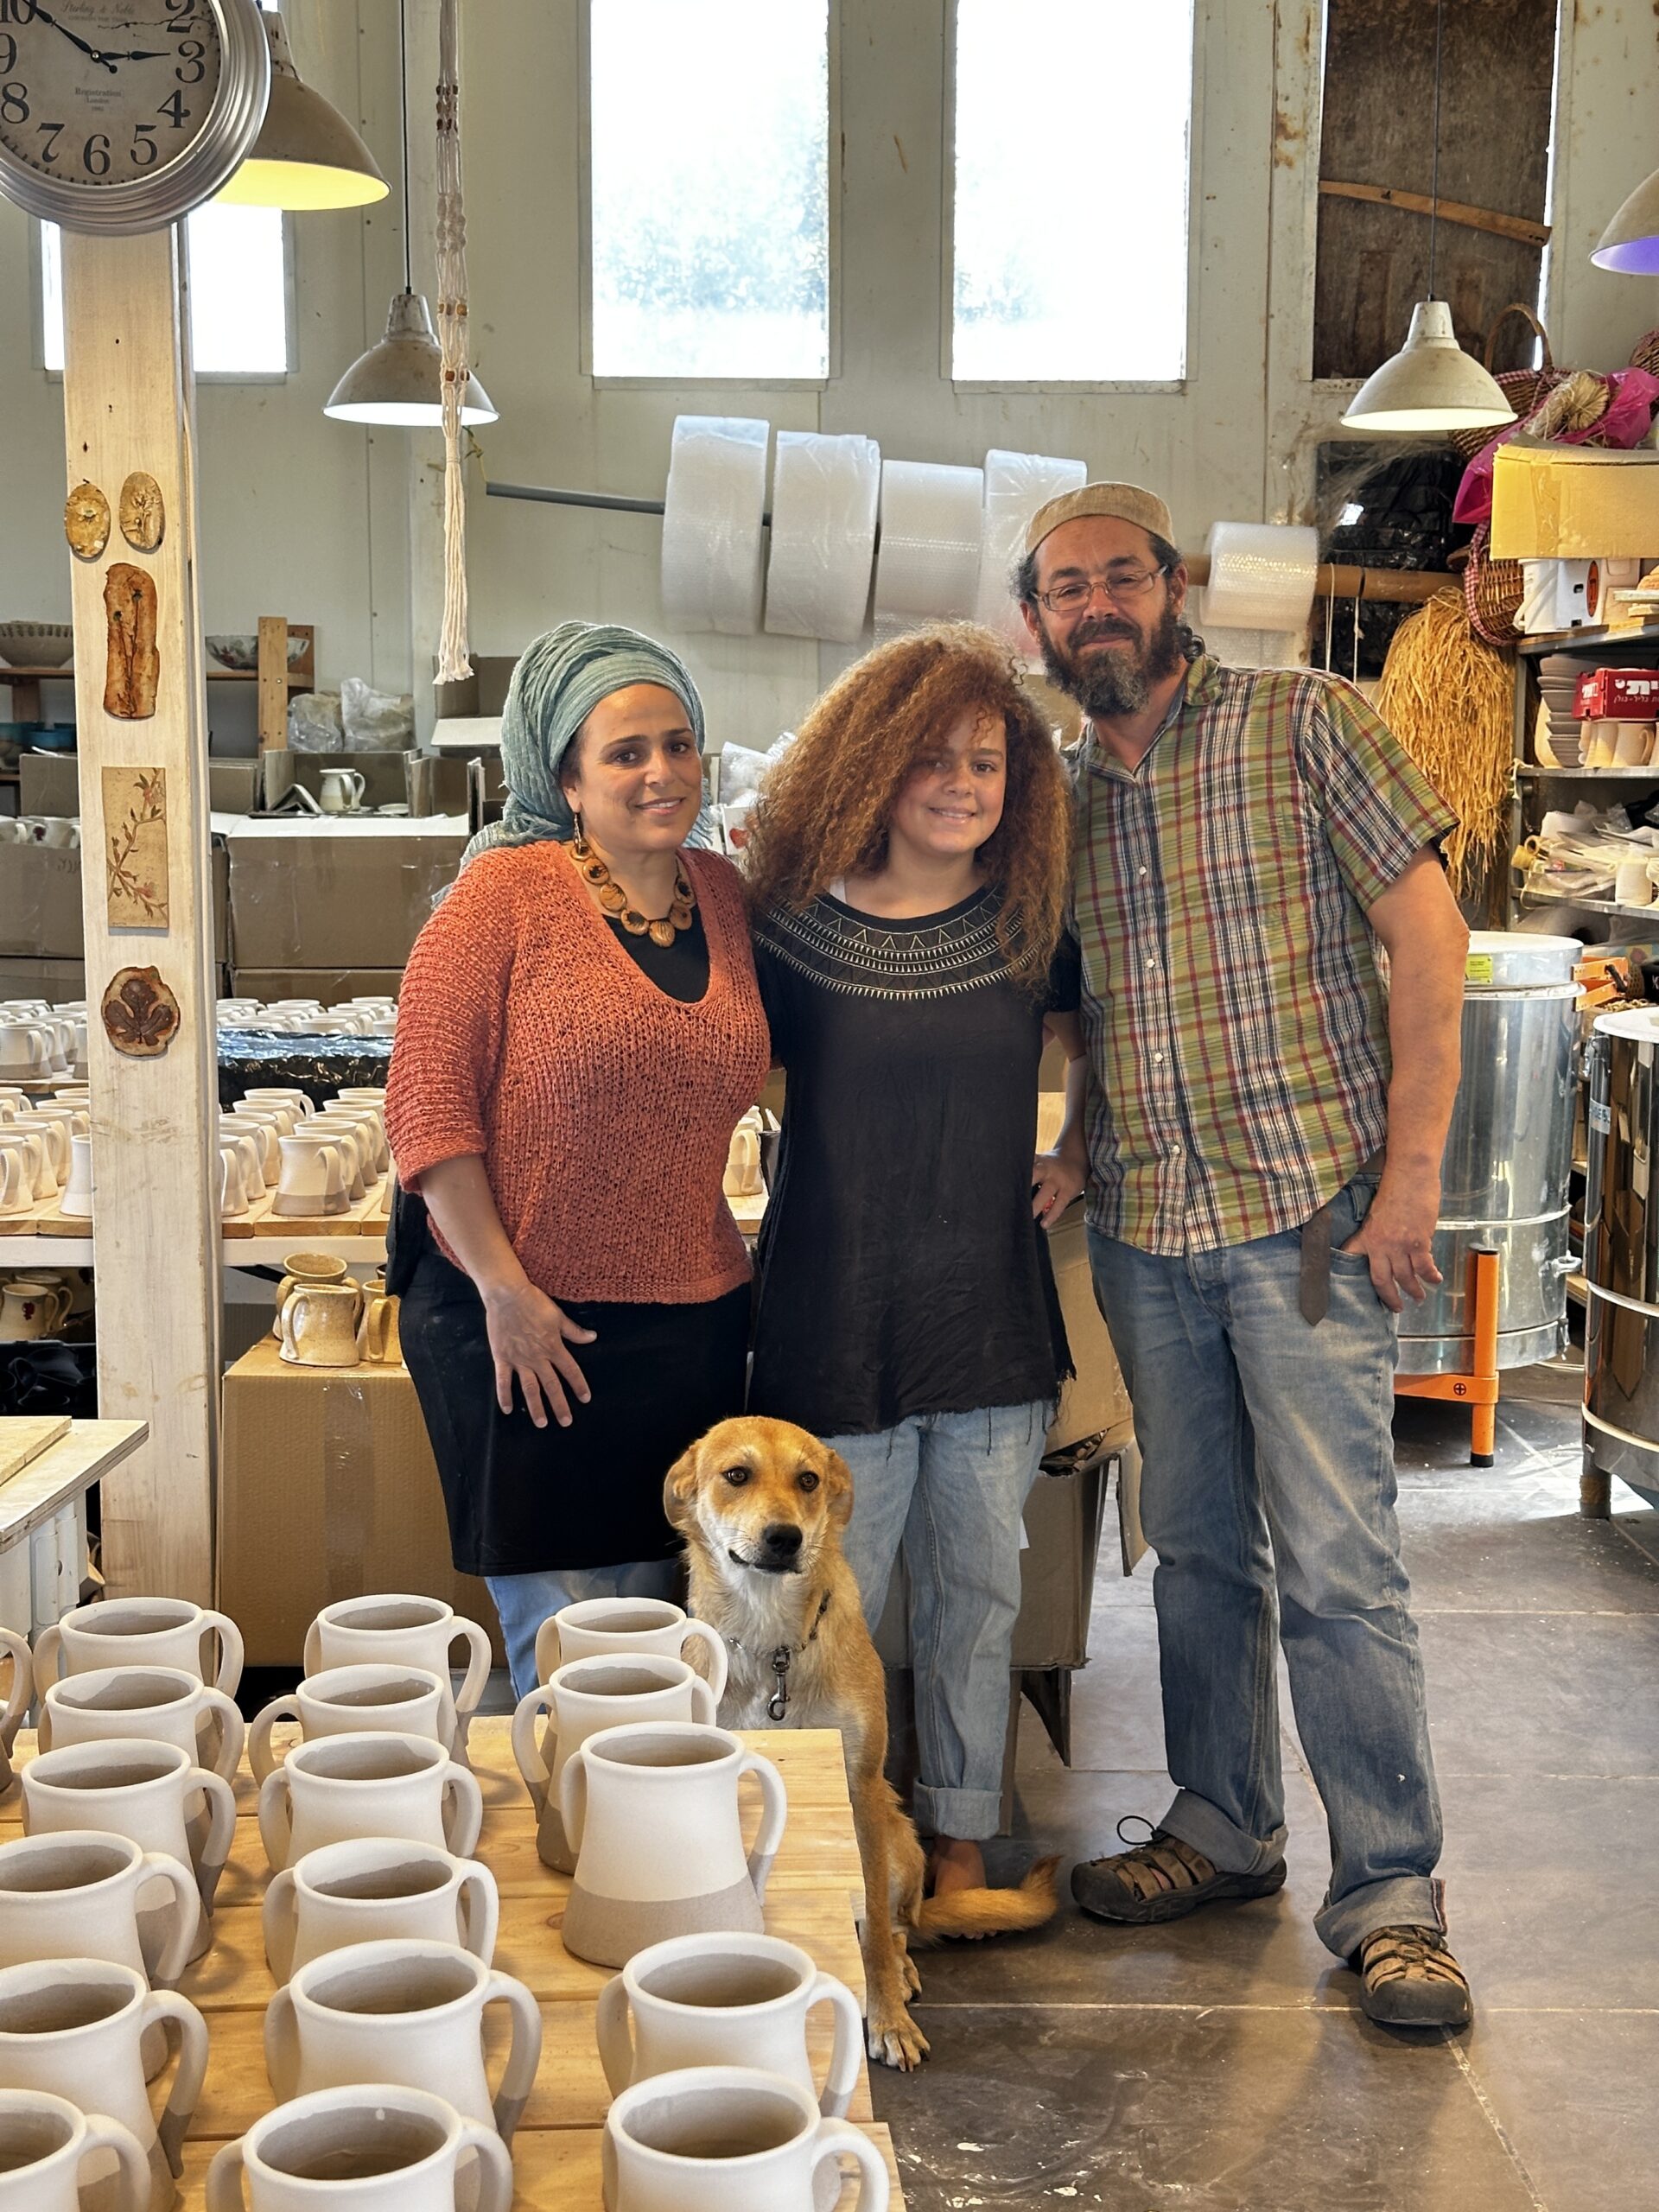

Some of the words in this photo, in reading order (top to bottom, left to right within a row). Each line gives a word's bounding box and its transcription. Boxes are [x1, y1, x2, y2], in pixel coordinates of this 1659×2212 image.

[0, 0, 37, 24] 10
[166, 0, 195, 33] 2
[0, 33, 17, 74] 9
[175, 41, 206, 83] 3
[1, 82, 29, 124] 8
[156, 90, 190, 128] 4
[35, 123, 65, 162] 7
[83, 134, 111, 175] 6
[130, 124, 157, 165] 5
